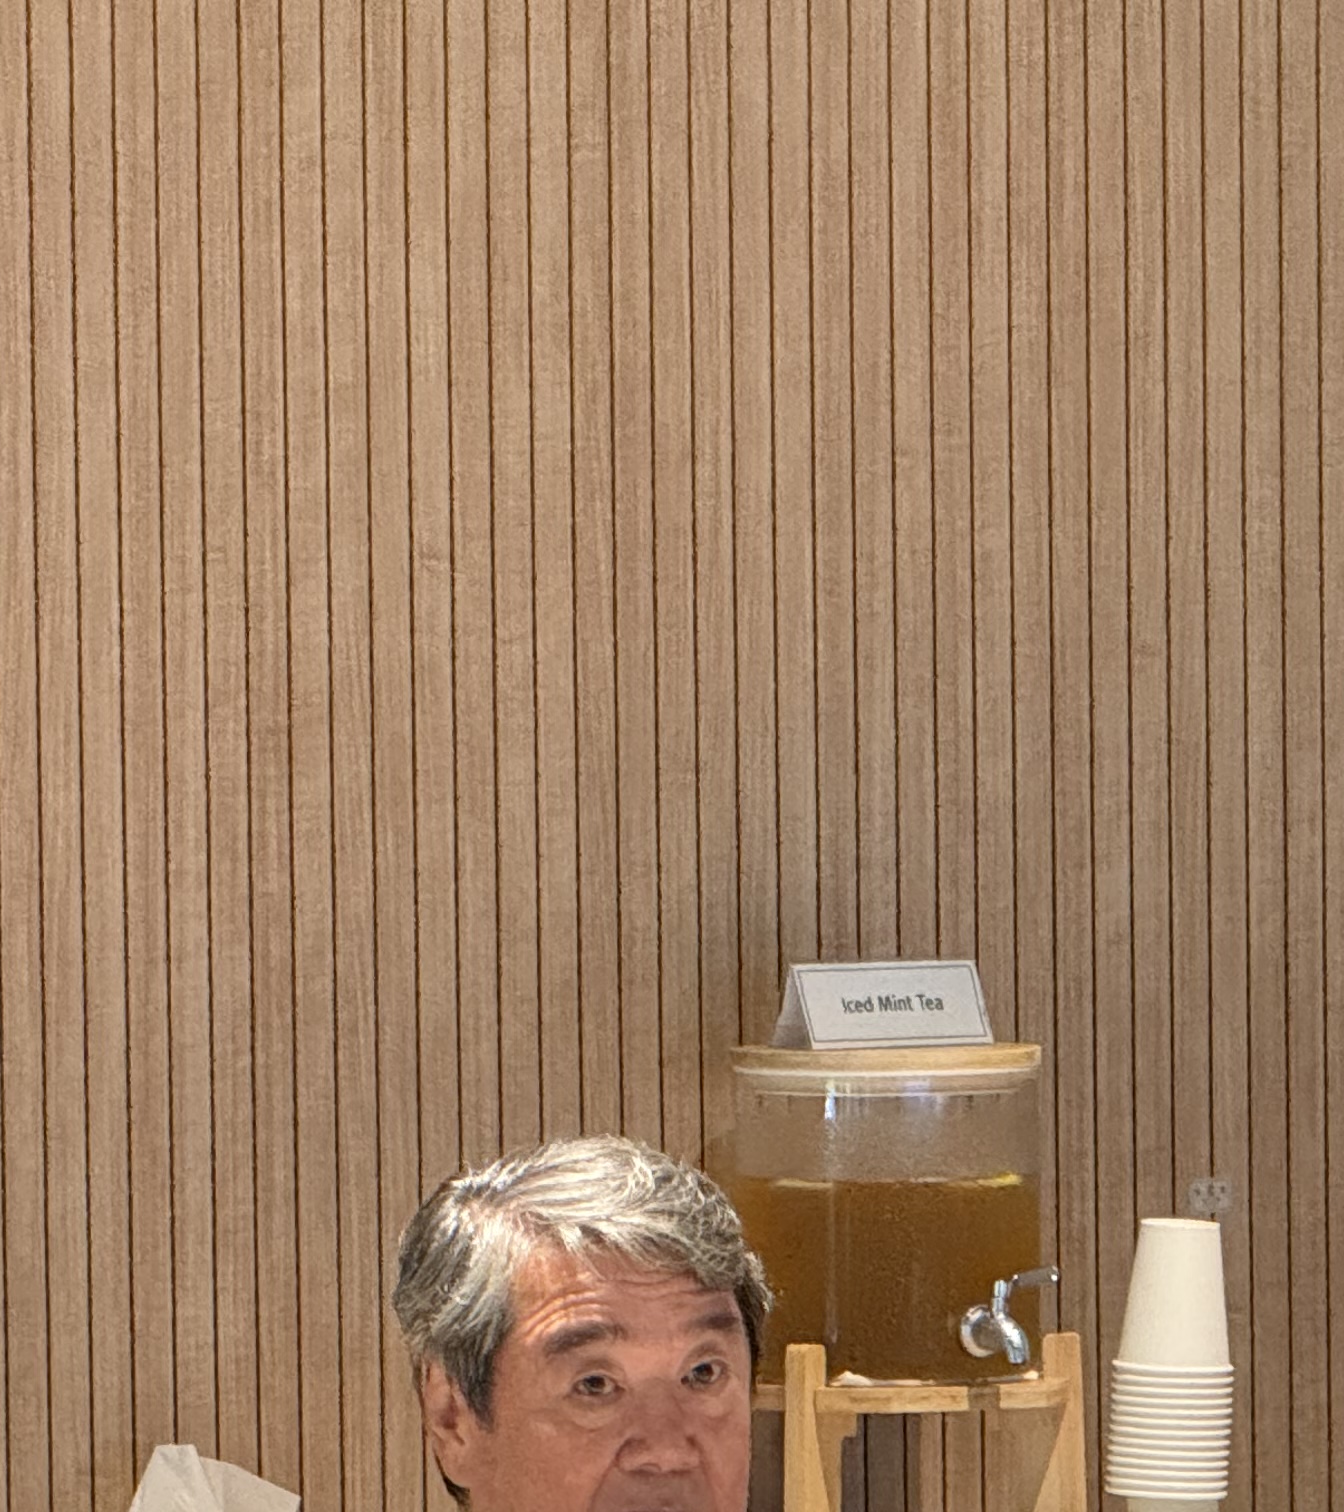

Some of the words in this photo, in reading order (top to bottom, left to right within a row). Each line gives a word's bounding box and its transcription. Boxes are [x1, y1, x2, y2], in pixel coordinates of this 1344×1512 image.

[841, 996, 875, 1014] Iced
[877, 994, 914, 1012] Mint
[915, 993, 945, 1011] Tea
